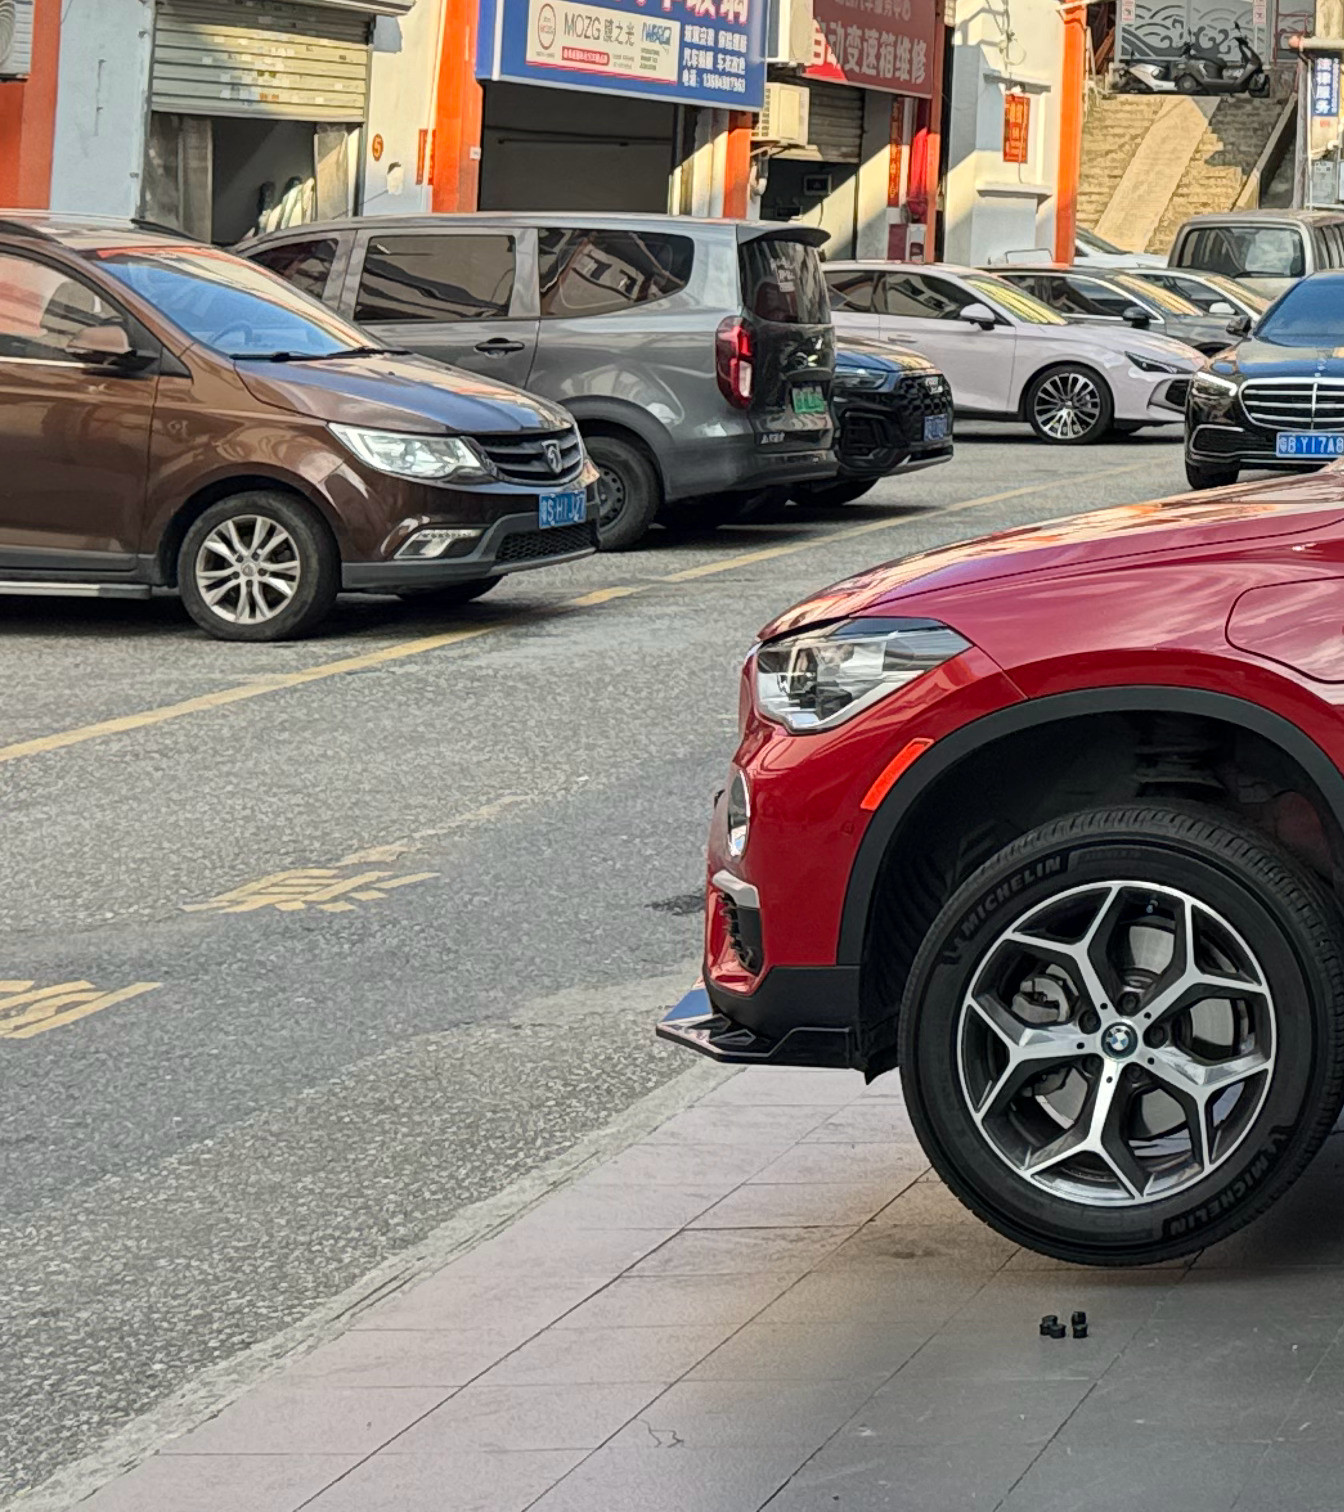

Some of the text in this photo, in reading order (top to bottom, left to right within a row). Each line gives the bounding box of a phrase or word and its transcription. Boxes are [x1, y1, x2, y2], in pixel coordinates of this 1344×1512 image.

[563, 12, 601, 40] MOZG
[805, 16, 927, 84] 自动变速箱维修
[961, 855, 1061, 937] MICHELIN
